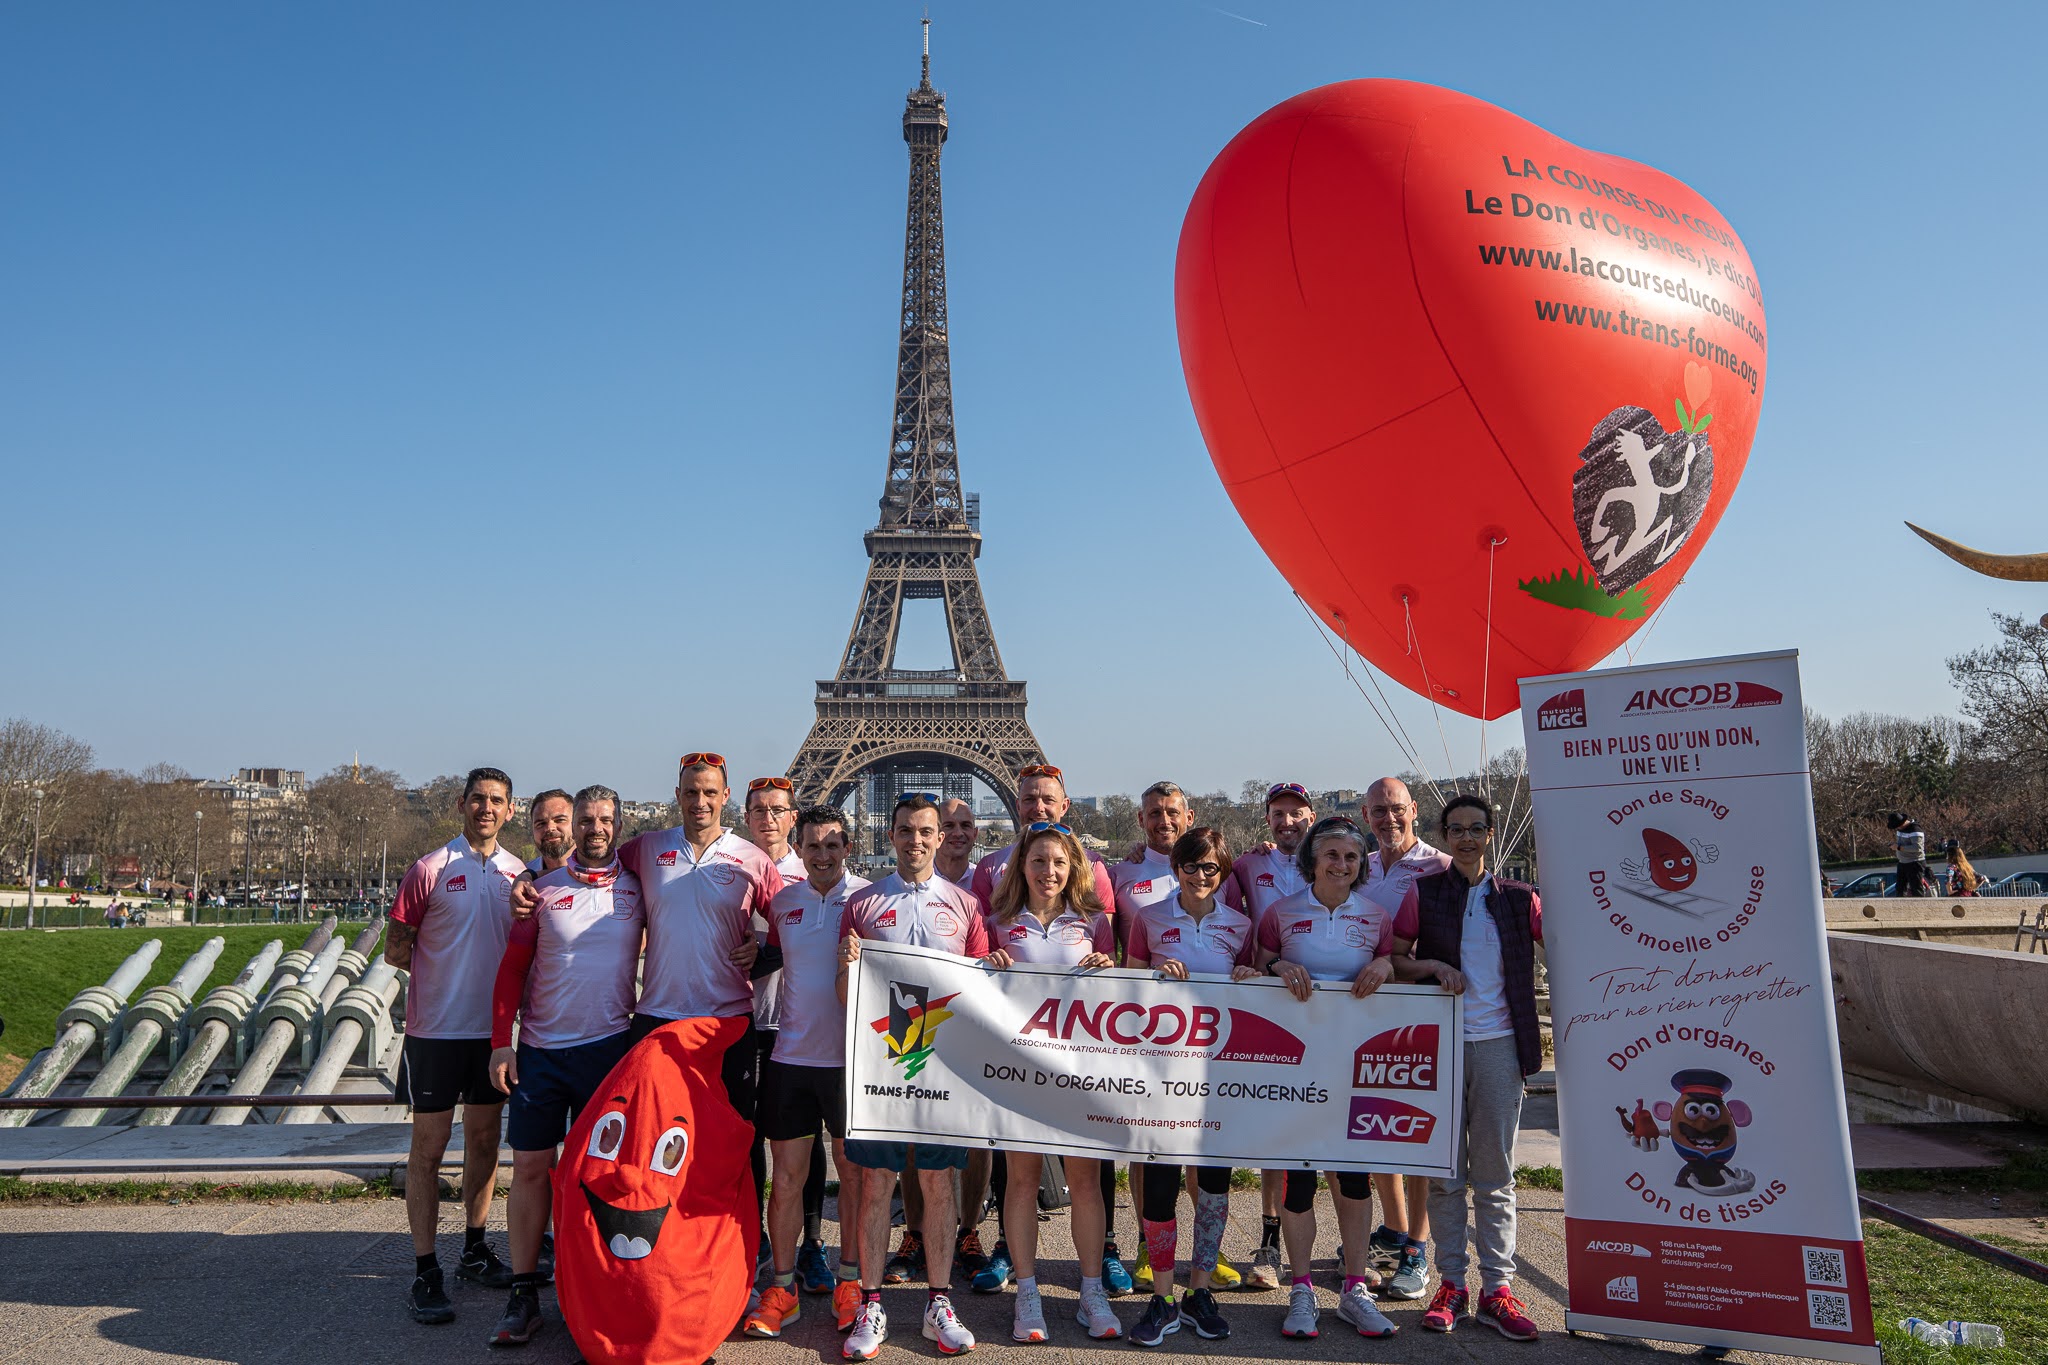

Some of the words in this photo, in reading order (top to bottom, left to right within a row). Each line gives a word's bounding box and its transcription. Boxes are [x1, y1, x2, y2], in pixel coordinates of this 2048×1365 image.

[1502, 155, 1543, 181] LA
[1547, 165, 1646, 212] COURSE
[1643, 197, 1681, 226] DU
[1682, 213, 1740, 255] CŒUR
[1465, 189, 1503, 215] Le
[1511, 193, 1572, 225] Don
[1579, 207, 1702, 268] d'Organes,
[1702, 248, 1721, 276] je
[1723, 260, 1746, 290] dis
[1478, 245, 1765, 354] www.lacourseducoeur.com
[1535, 300, 1758, 395] www.trans-forme.org
[1541, 706, 1583, 716] mutuelle
[1541, 712, 1584, 729] MGC
[1563, 738, 1602, 758] BIEN
[1608, 735, 1651, 755] PLUS
[1656, 730, 1710, 752] QU'UN
[1716, 726, 1760, 748] DON,
[1622, 757, 1657, 776] UNE
[1661, 755, 1690, 774] VIE
[1606, 797, 1645, 826] Don
[1648, 790, 1674, 805] de
[1679, 789, 1731, 821] Sang
[448, 884, 466, 892] MGC
[1133, 886, 1152, 894] MGC
[1589, 870, 1612, 911] Don
[1609, 911, 1634, 936] de
[1637, 930, 1713, 953] moelle
[1716, 864, 1765, 943] osseuse
[1162, 936, 1180, 944] MGC
[1589, 966, 1674, 1004] Tout
[1674, 958, 1773, 995] donner
[1563, 1007, 1620, 1043] pour
[1625, 1005, 1653, 1019] ne
[1657, 997, 1704, 1014] rien
[1709, 976, 1811, 1028] regretter
[1010, 1038, 1068, 1050] ASSOCIATION
[1068, 1045, 1118, 1055] NATIONALE
[1120, 1048, 1138, 1056] DES
[1139, 1049, 1190, 1058] CHEMINOTS
[1191, 1050, 1214, 1059] POUR
[1253, 1052, 1298, 1063] BÉNÉVOLE
[1361, 1053, 1433, 1063] mutuelle
[1606, 1034, 1652, 1072] Don
[1655, 1023, 1777, 1077] d'organes
[983, 1063, 1027, 1083] DON
[1034, 1070, 1153, 1098] D'ORGANES,
[1162, 1080, 1211, 1097] TOUS
[1217, 1081, 1329, 1103] CONCERNÉS
[1358, 1063, 1432, 1086] MGC
[1086, 1114, 1222, 1130] www.dondusang-sncf.org
[1351, 1113, 1430, 1137] SNCF
[1624, 1171, 1673, 1214] Don
[1679, 1203, 1711, 1223] de
[1717, 1177, 1788, 1223] tissus
[1660, 1240, 1673, 1248] 168
[1696, 1243, 1722, 1252] Fayette
[1660, 1249, 1682, 1257] 75010
[1683, 1251, 1705, 1259] PARIS
[1661, 1258, 1733, 1272] dondusang-sncf.org
[1609, 1289, 1636, 1300] MGC
[1676, 1283, 1696, 1291] place
[1730, 1288, 1761, 1298] Georges
[1687, 1293, 1709, 1301] PARIS
[1709, 1295, 1733, 1303] Cedex
[1734, 1297, 1744, 1305] 13
[1665, 1299, 1723, 1311] mutuelleMGC.fr
